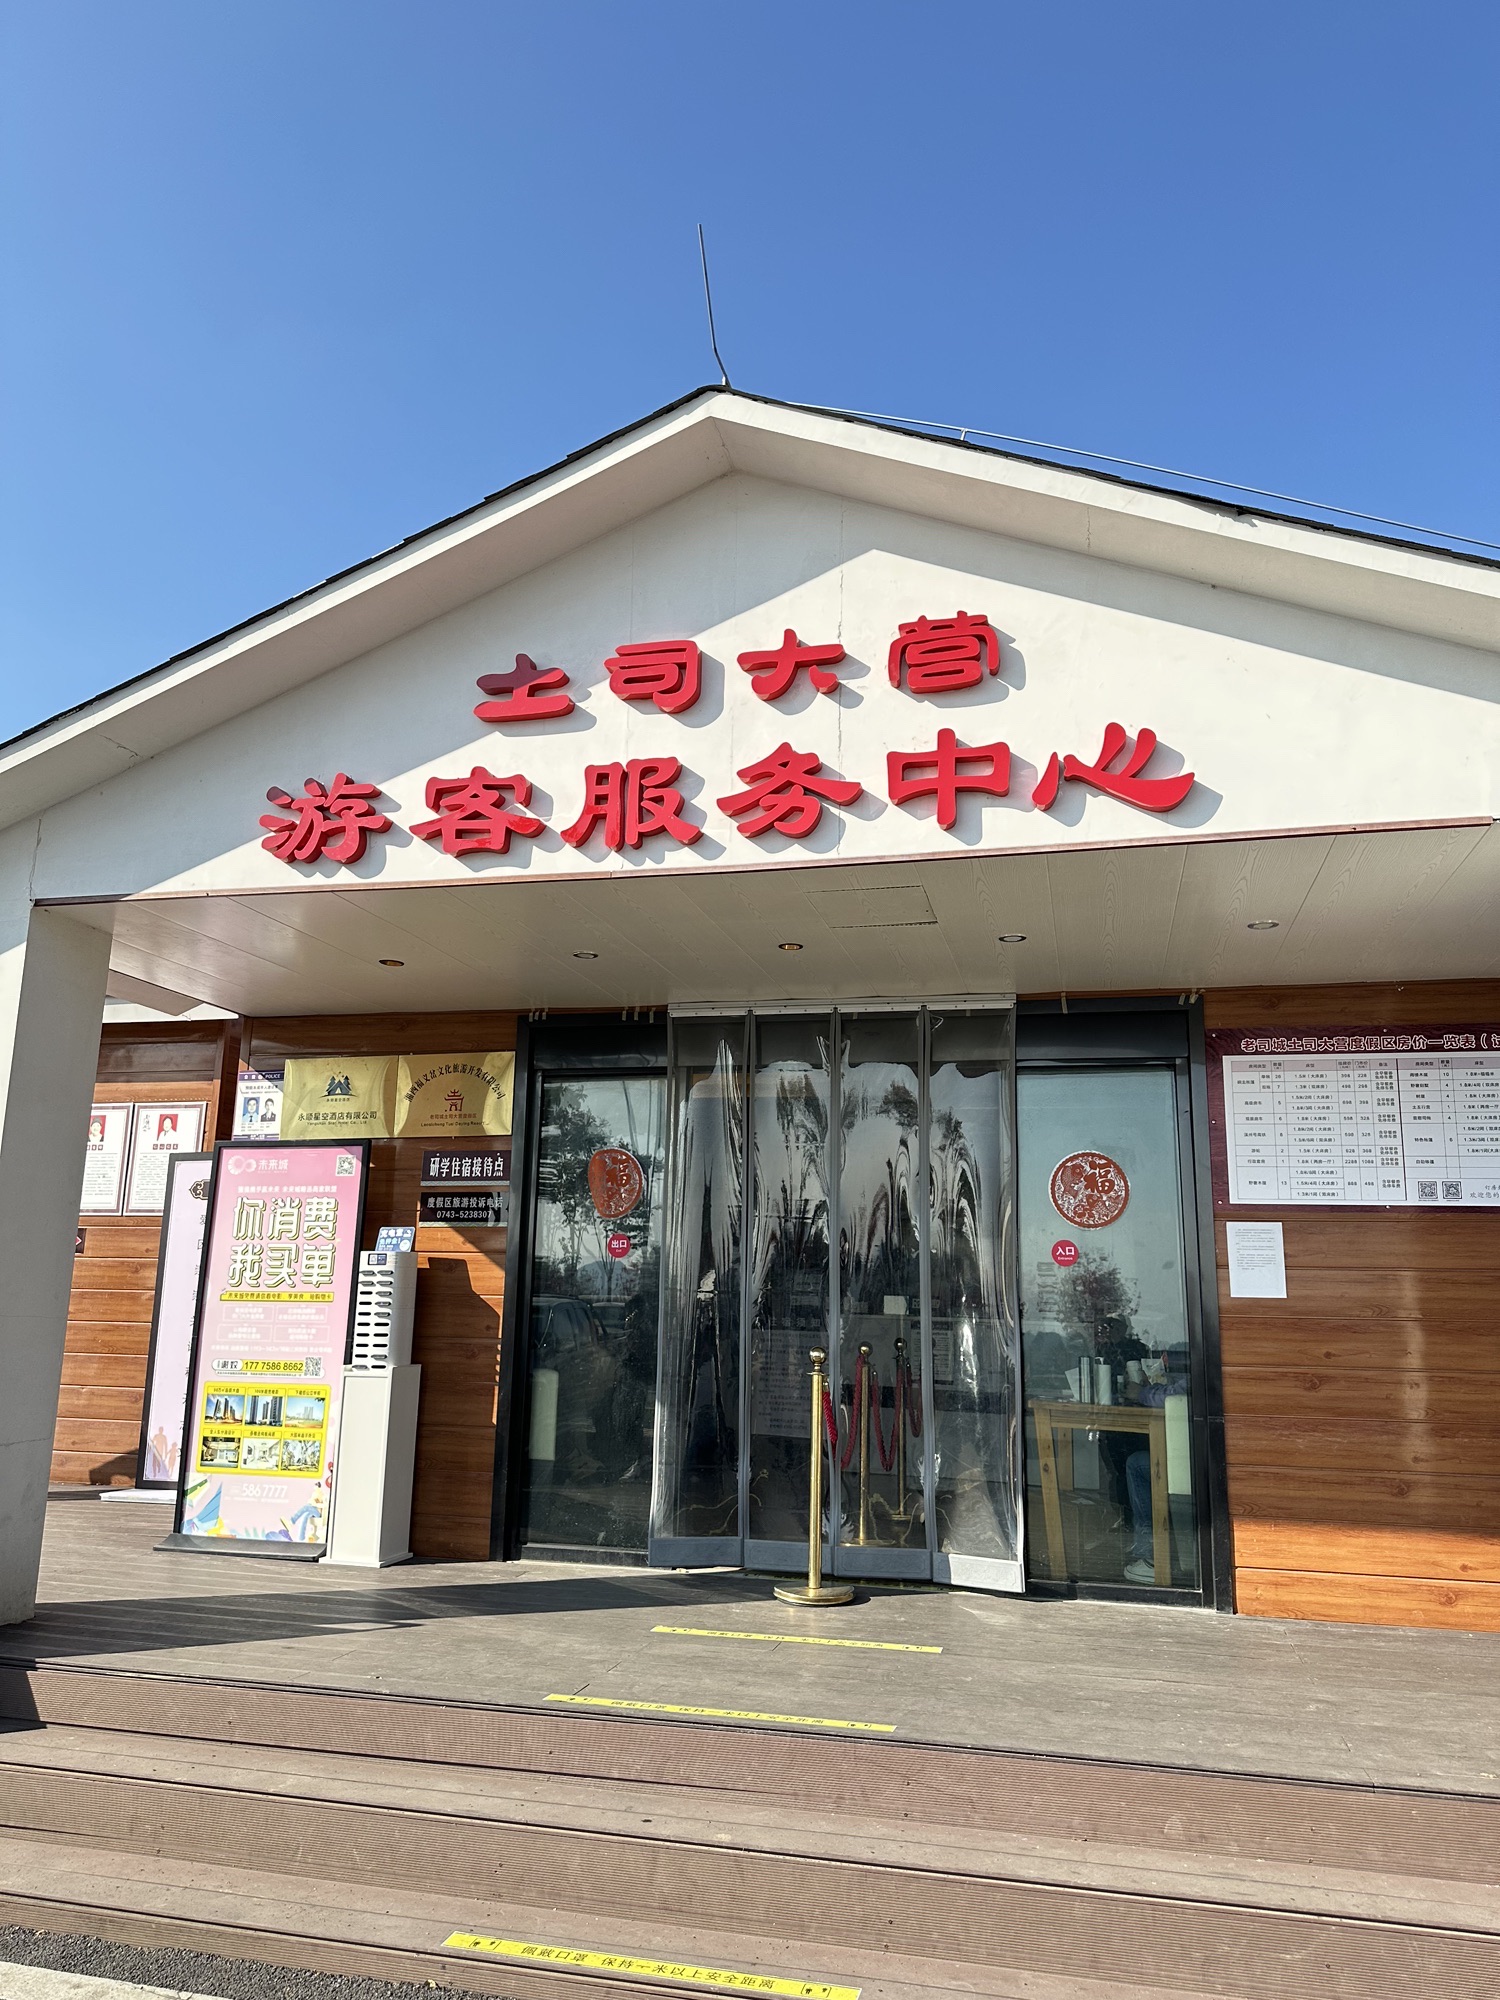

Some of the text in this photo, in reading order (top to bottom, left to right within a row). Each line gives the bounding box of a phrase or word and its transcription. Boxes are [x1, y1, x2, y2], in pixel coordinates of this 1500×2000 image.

[473, 610, 1000, 724] 土司大营
[259, 722, 1195, 866] 游客服务中心
[297, 1111, 378, 1121] 永顺星空酒店有限公司
[258, 1159, 289, 1170] 未来城
[429, 1157, 504, 1177] 研学住宿接待点
[427, 1197, 503, 1208] 度假区旅游投诉电话
[232, 1197, 339, 1240] 你消费
[436, 1210, 492, 1219] 0743-5238307
[611, 1239, 627, 1248] 出口
[1056, 1246, 1075, 1256] 入口
[228, 1243, 335, 1288] 我买单
[244, 1361, 259, 1369] 177
[261, 1361, 281, 1370] 7586
[282, 1362, 304, 1371] 8662
[521, 1945, 776, 1988] 佩戴口罩 保持一米以上安全距离
